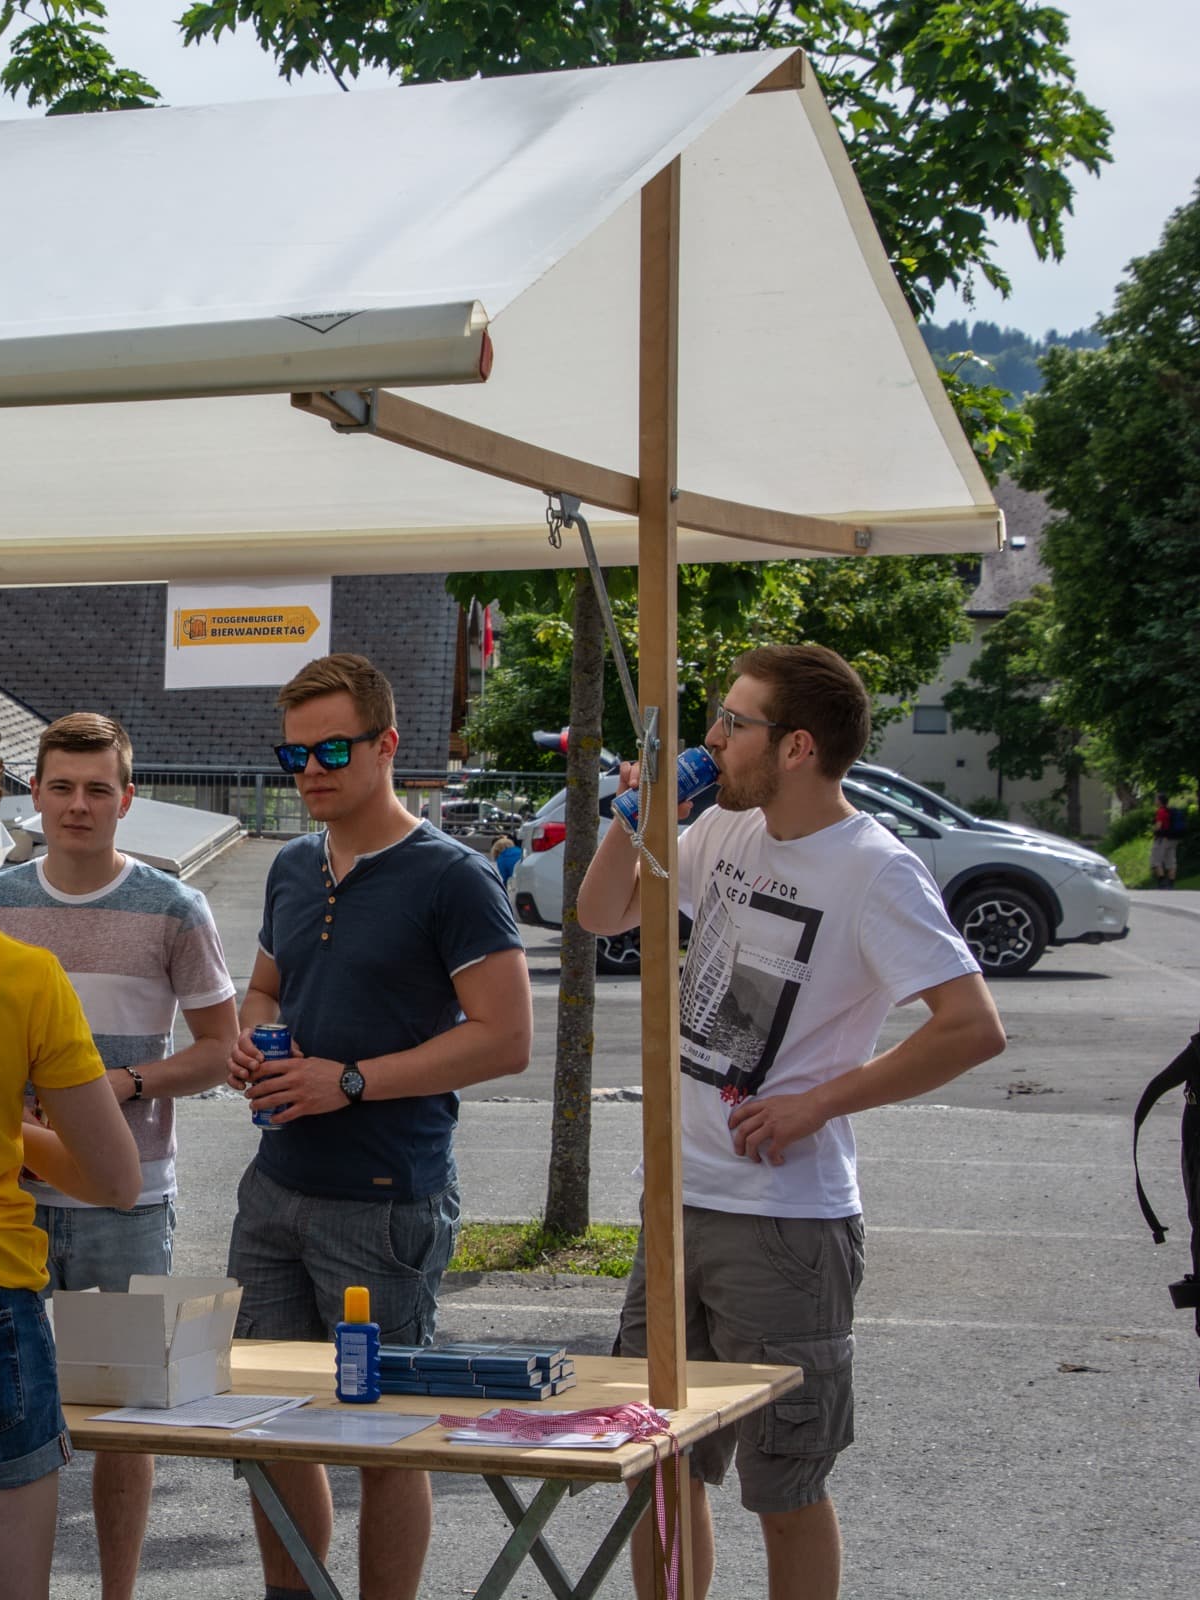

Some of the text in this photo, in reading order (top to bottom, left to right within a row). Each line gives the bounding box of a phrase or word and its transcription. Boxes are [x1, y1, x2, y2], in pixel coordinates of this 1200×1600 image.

[211, 615, 284, 624] TOGGENBURGER
[210, 625, 305, 637] BIERWANDERTAG
[726, 886, 748, 905] CED
